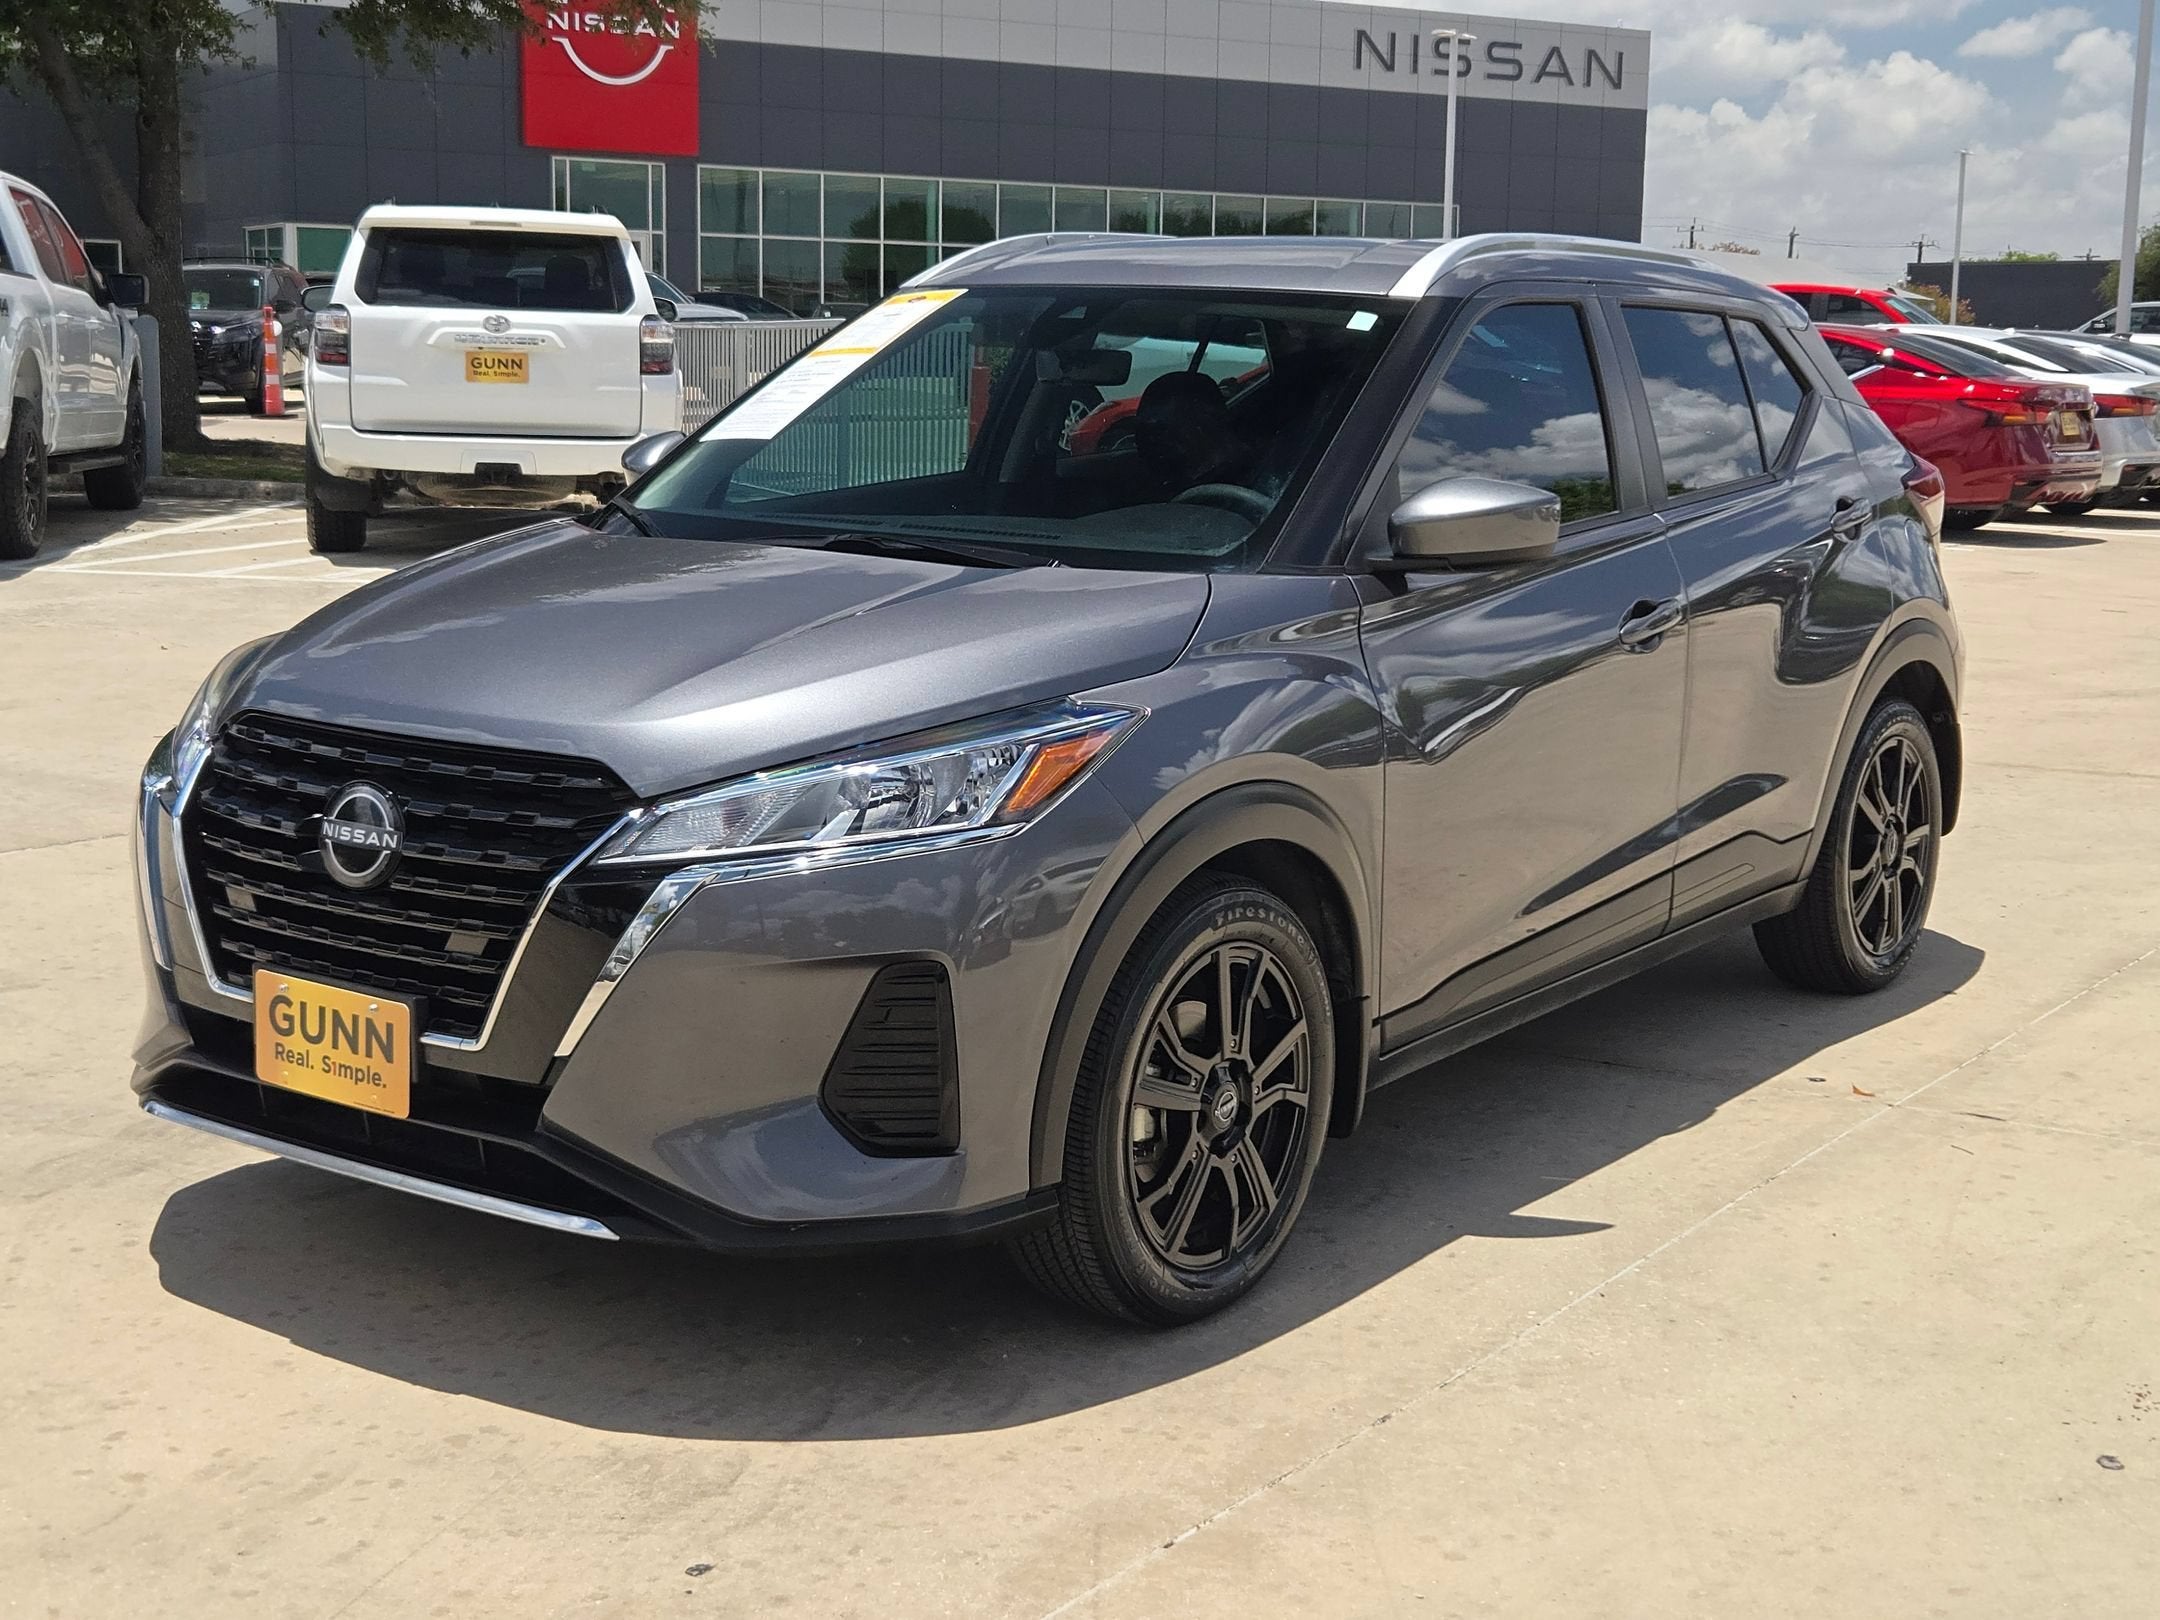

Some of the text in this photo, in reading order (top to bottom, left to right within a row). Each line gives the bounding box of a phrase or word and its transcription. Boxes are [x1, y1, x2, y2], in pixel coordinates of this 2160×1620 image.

[1354, 29, 1624, 90] NISSAN
[471, 357, 523, 370] GUNN
[323, 821, 398, 848] NISSAN
[1215, 906, 1306, 946] Firestone
[269, 994, 394, 1065] GUNN
[274, 1041, 314, 1070] Real.
